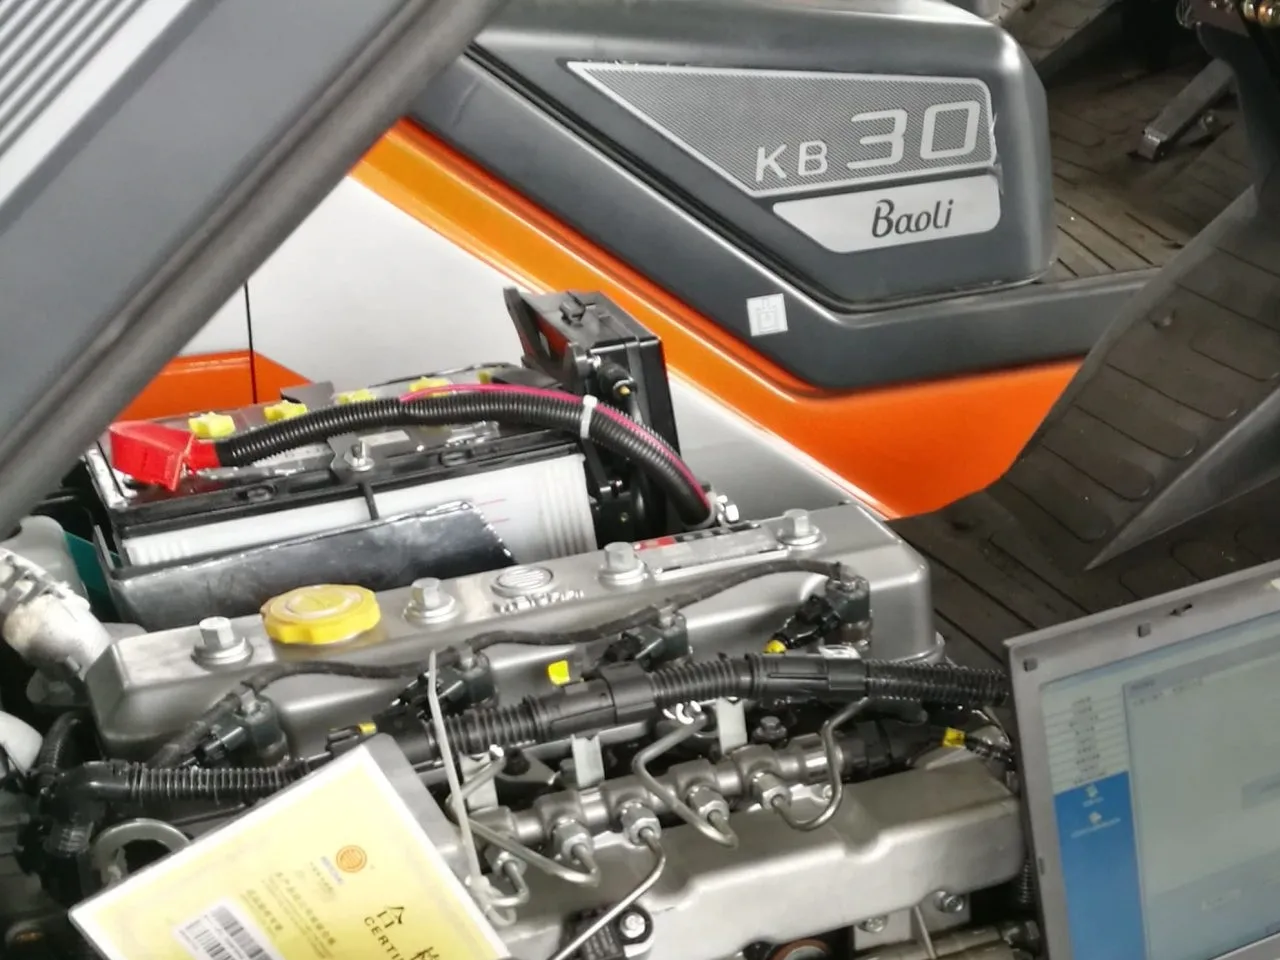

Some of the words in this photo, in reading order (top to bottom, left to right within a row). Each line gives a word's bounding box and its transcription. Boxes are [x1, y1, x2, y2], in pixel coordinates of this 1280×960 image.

[754, 140, 829, 183] KB
[846, 100, 981, 170] 30
[870, 198, 954, 239] Baoli
